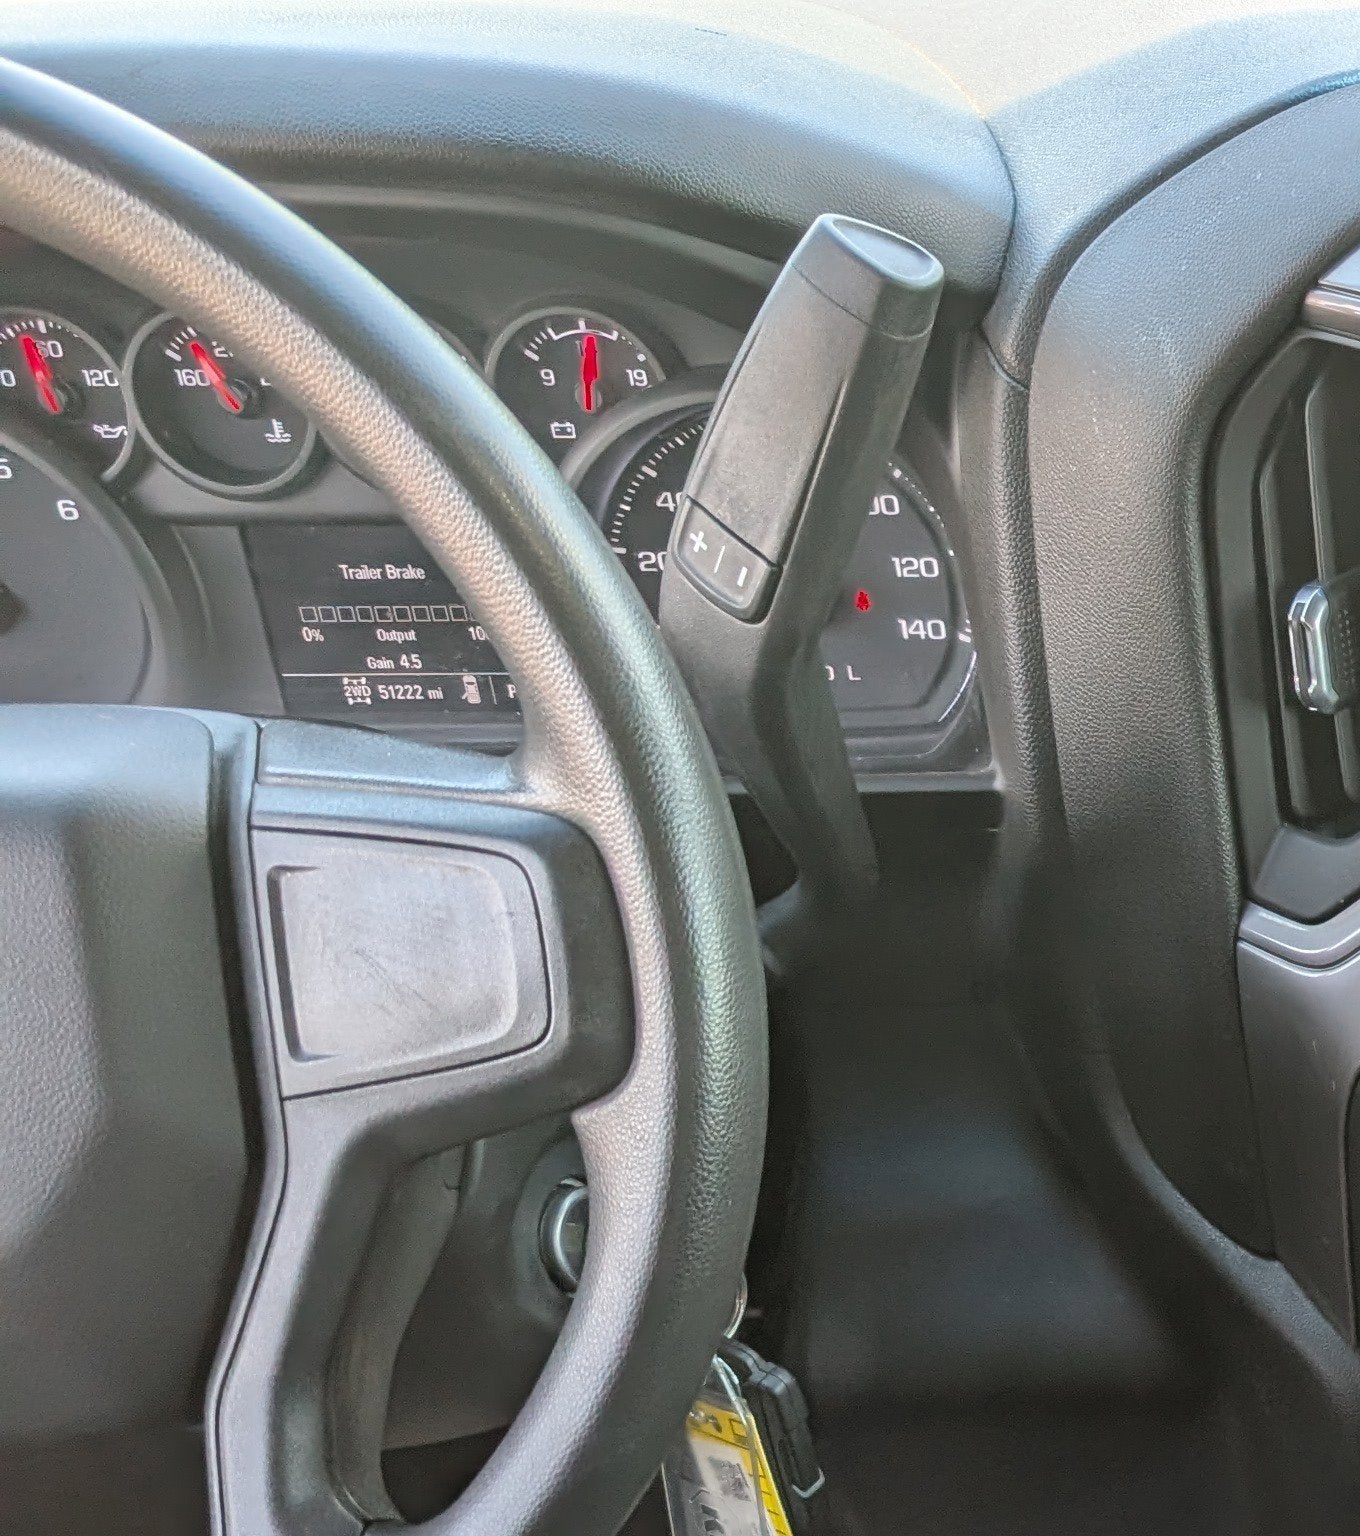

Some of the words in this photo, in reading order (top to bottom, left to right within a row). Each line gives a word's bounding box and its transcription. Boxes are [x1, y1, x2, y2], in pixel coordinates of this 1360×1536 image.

[81, 368, 119, 387] 120
[174, 368, 211, 387] 160
[540, 368, 556, 387] 9
[625, 368, 649, 387] 19
[56, 499, 80, 521] 6
[338, 563, 382, 580] Trailer
[385, 563, 427, 580] Brake
[891, 556, 940, 578] 120
[301, 626, 325, 643] 0%
[375, 628, 418, 644] Output
[897, 618, 947, 641] 140
[366, 655, 395, 670] Gain
[399, 653, 423, 670] 4.5
[343, 685, 372, 698] 2WD
[377, 684, 425, 700] 51222
[427, 686, 444, 700] mi
